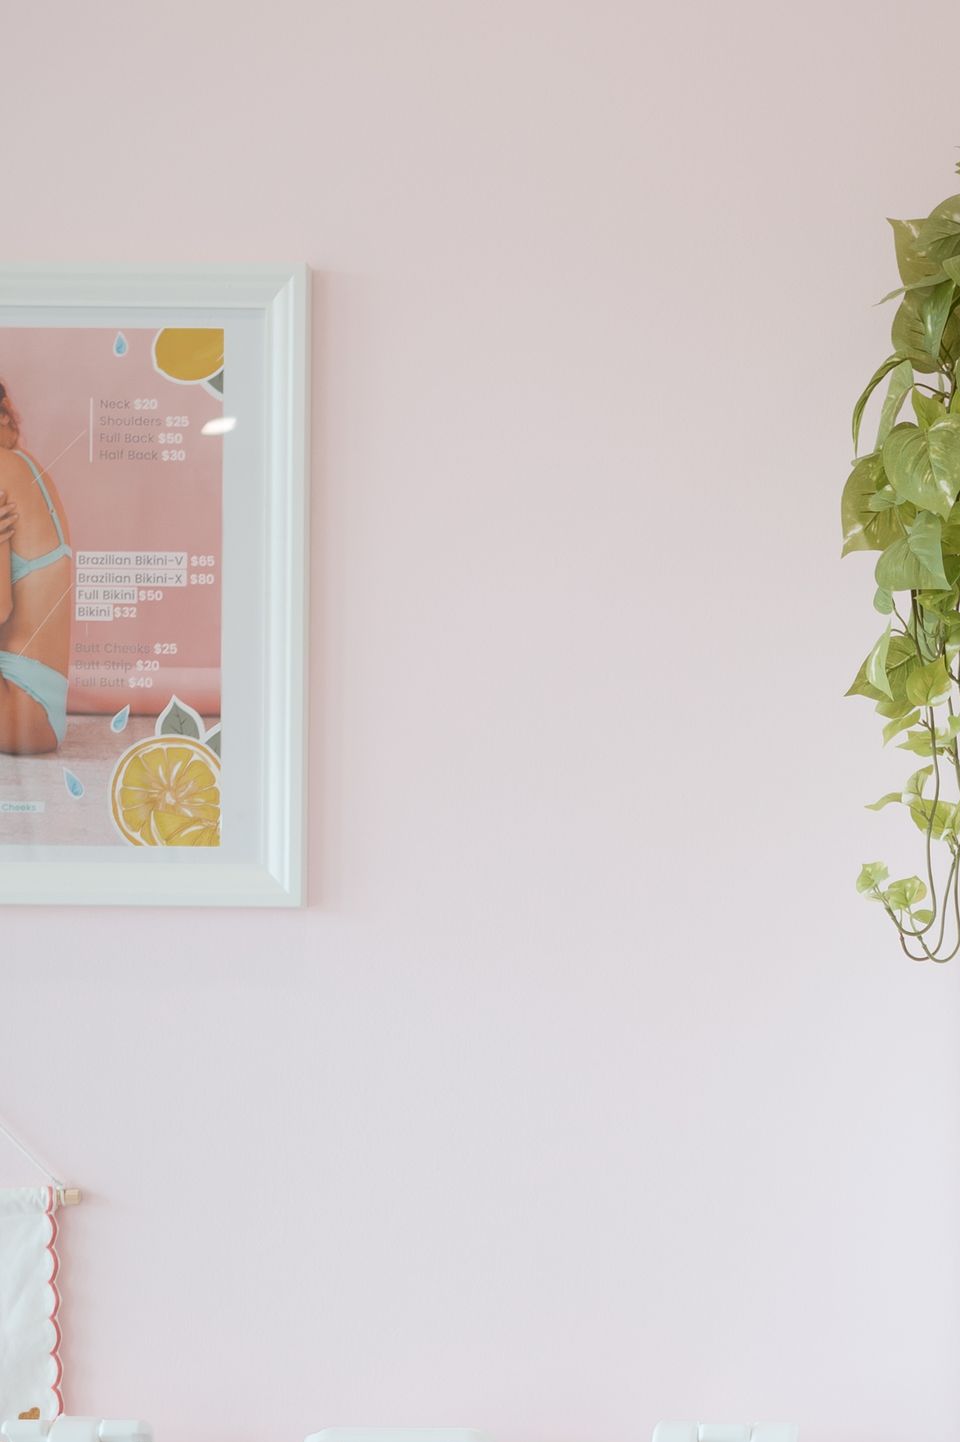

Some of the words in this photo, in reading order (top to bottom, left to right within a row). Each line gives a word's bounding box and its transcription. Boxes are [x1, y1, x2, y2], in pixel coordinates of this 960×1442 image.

[100, 400, 130, 409] Neck
[134, 399, 158, 410] $20
[100, 416, 162, 426] Shoulders
[166, 416, 189, 427] $25
[100, 433, 121, 443] Full
[125, 433, 154, 443] Back
[158, 433, 182, 444] $50
[100, 450, 123, 460] Half
[128, 450, 157, 460] Back
[162, 450, 185, 461] $30
[78, 555, 130, 566] Brazilian
[135, 555, 183, 566] Bikini-V
[78, 573, 130, 584] Brazilian
[135, 573, 182, 584] Bikini-X
[190, 574, 214, 584] $80
[78, 590, 98, 600] Full
[103, 590, 135, 600] Bikini
[139, 590, 163, 601] $50
[78, 607, 110, 617] Bikini
[114, 607, 136, 618] $32
[154, 643, 177, 654] $25
[136, 660, 159, 671] $20
[128, 677, 152, 688] $40
